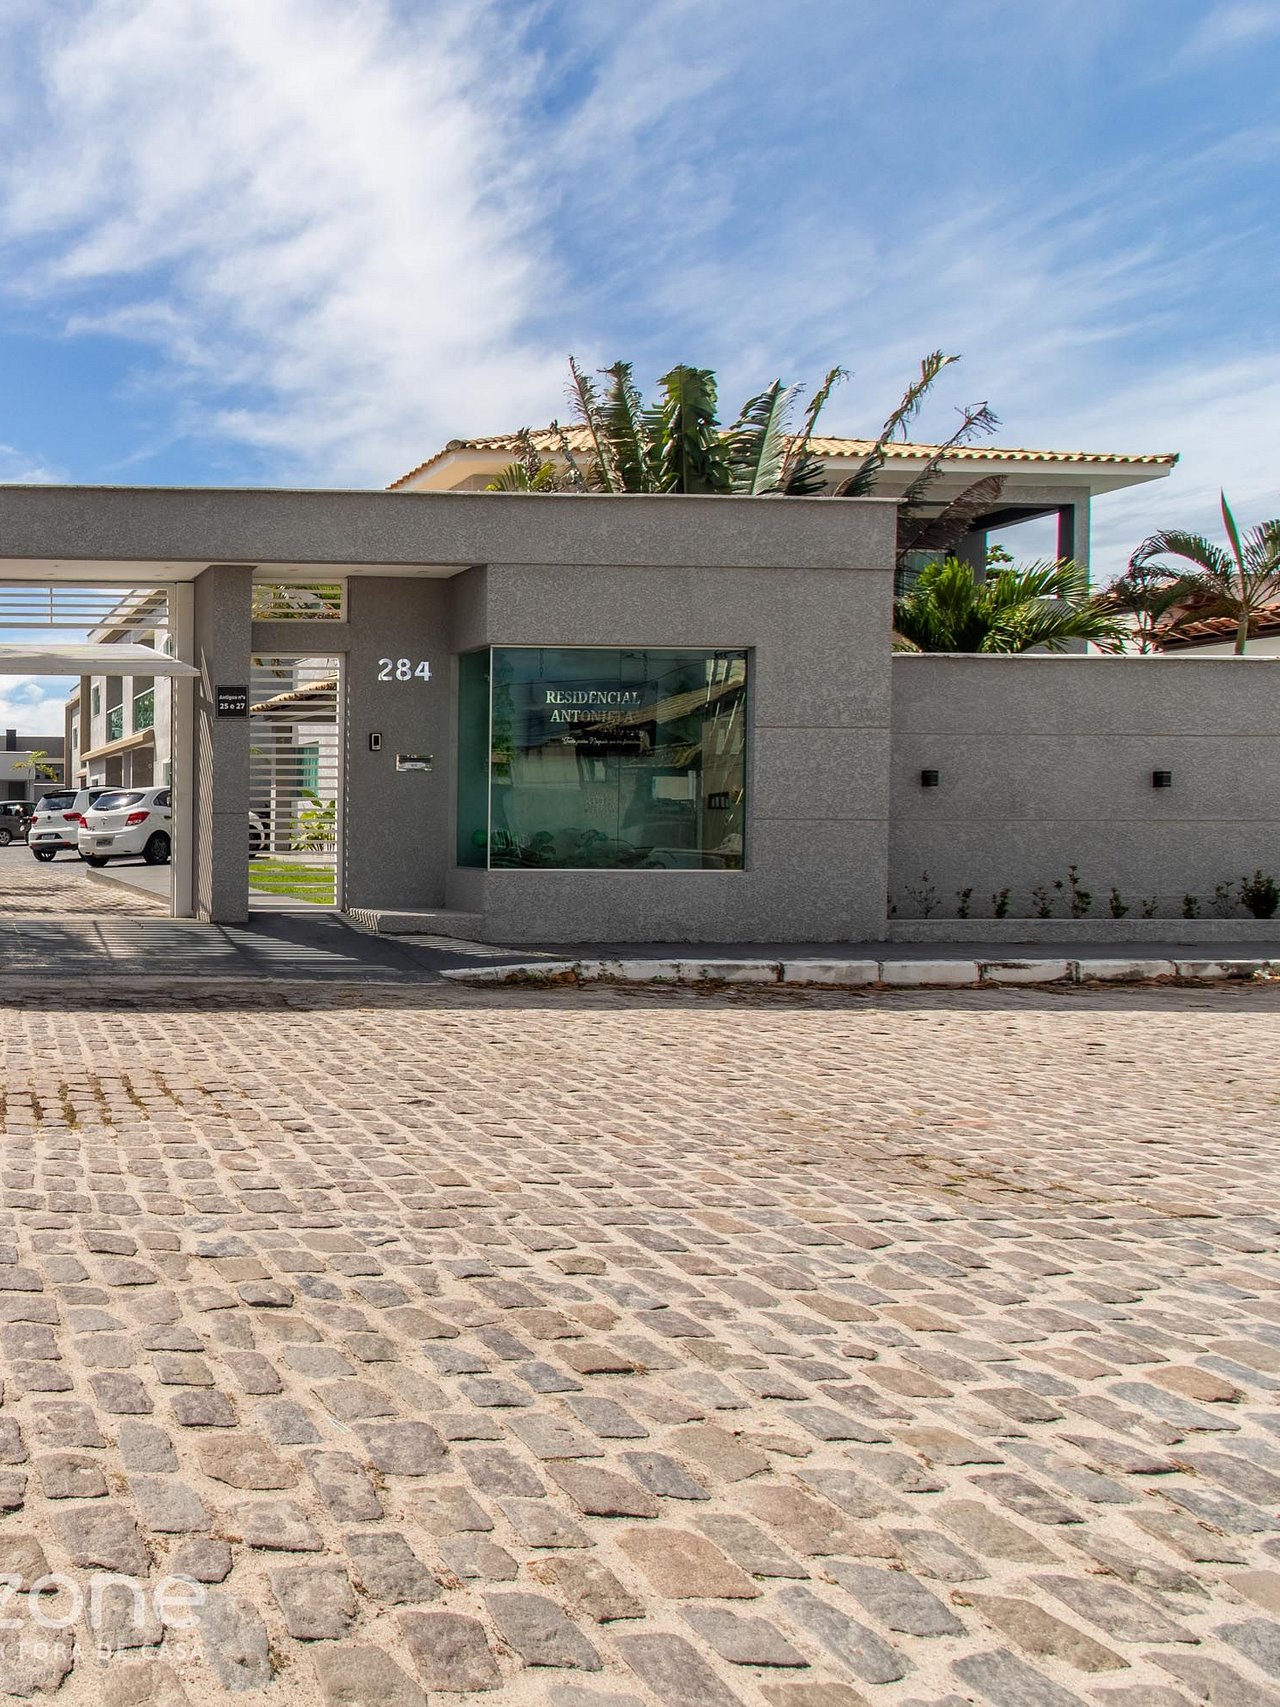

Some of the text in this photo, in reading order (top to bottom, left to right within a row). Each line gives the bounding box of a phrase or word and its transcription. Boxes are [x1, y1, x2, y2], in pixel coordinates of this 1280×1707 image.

[378, 658, 432, 681] 284
[545, 690, 641, 705] RESIDENCIAL
[219, 702, 229, 710] 25
[235, 702, 245, 710] 27
